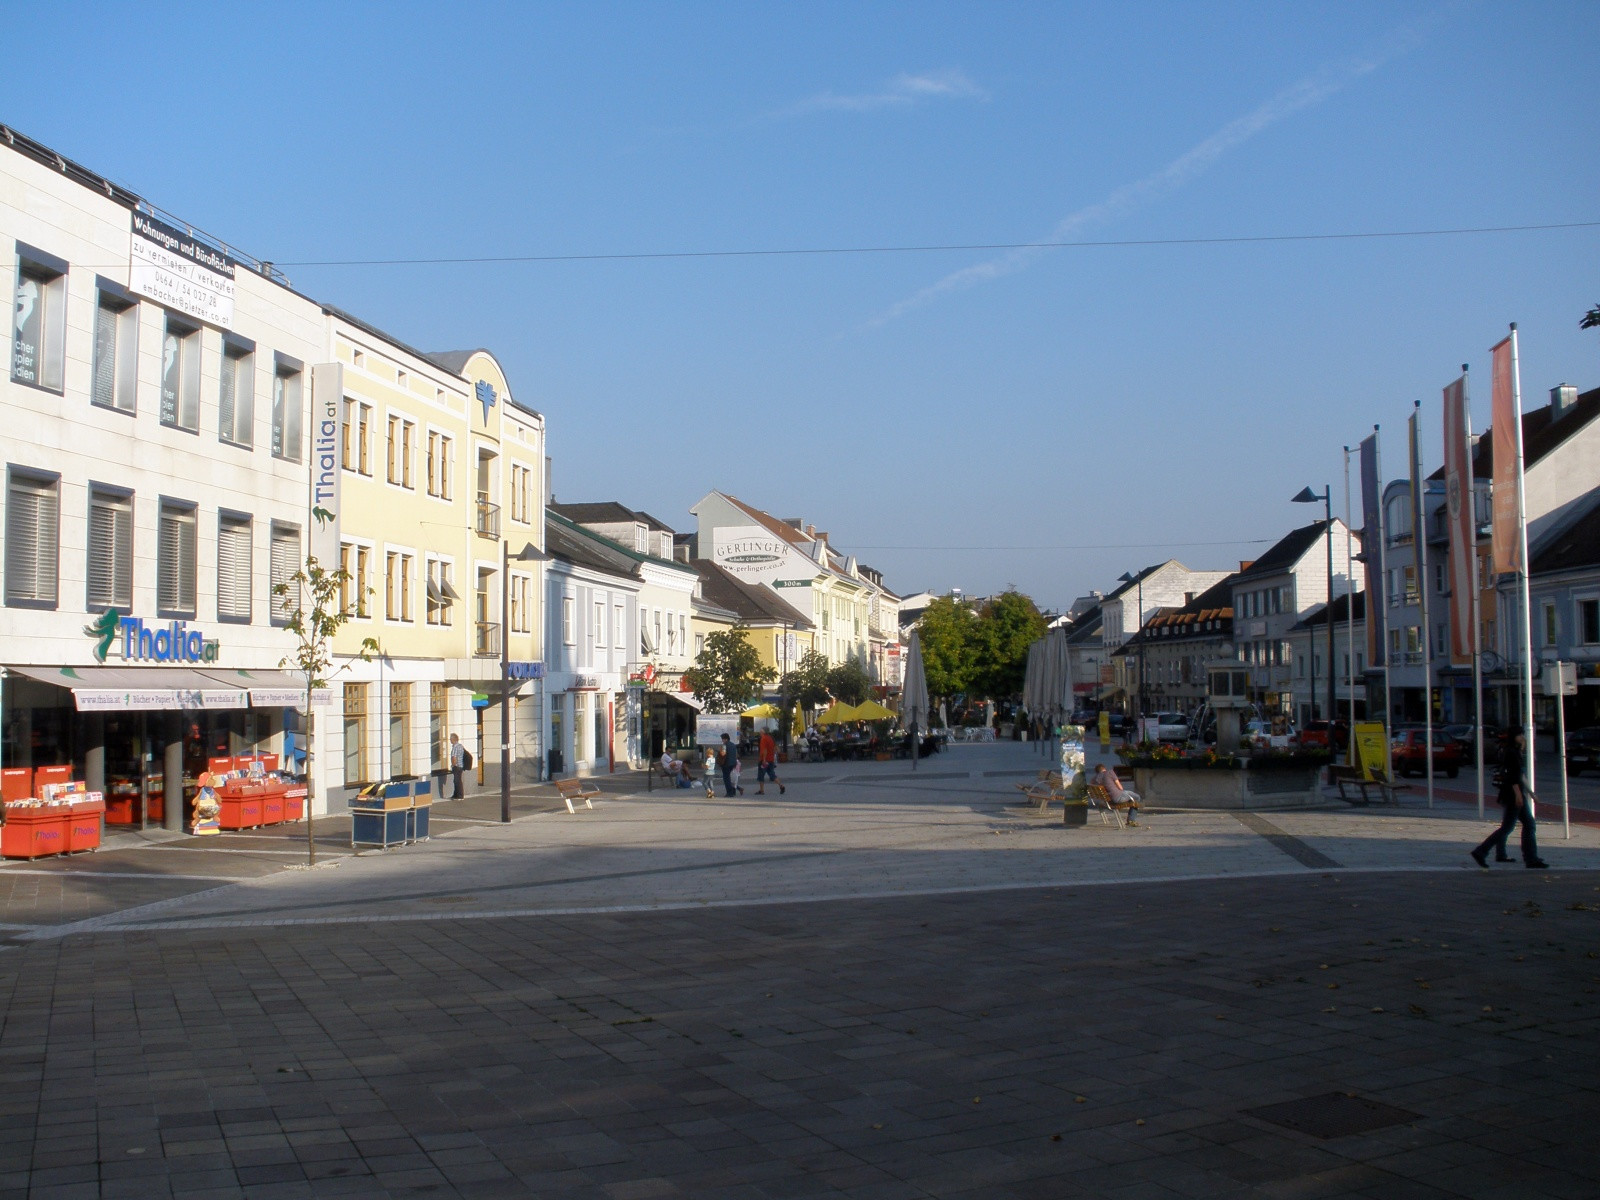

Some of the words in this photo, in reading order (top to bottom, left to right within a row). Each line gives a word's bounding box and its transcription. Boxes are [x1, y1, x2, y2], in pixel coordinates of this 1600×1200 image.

[134, 215, 179, 249] Wohnungen
[181, 243, 194, 257] und
[196, 247, 235, 276] Büroflächen
[134, 242, 144, 253] zu
[147, 250, 187, 274] vermieten
[182, 284, 191, 297] 54
[717, 542, 788, 556] GERLINGER
